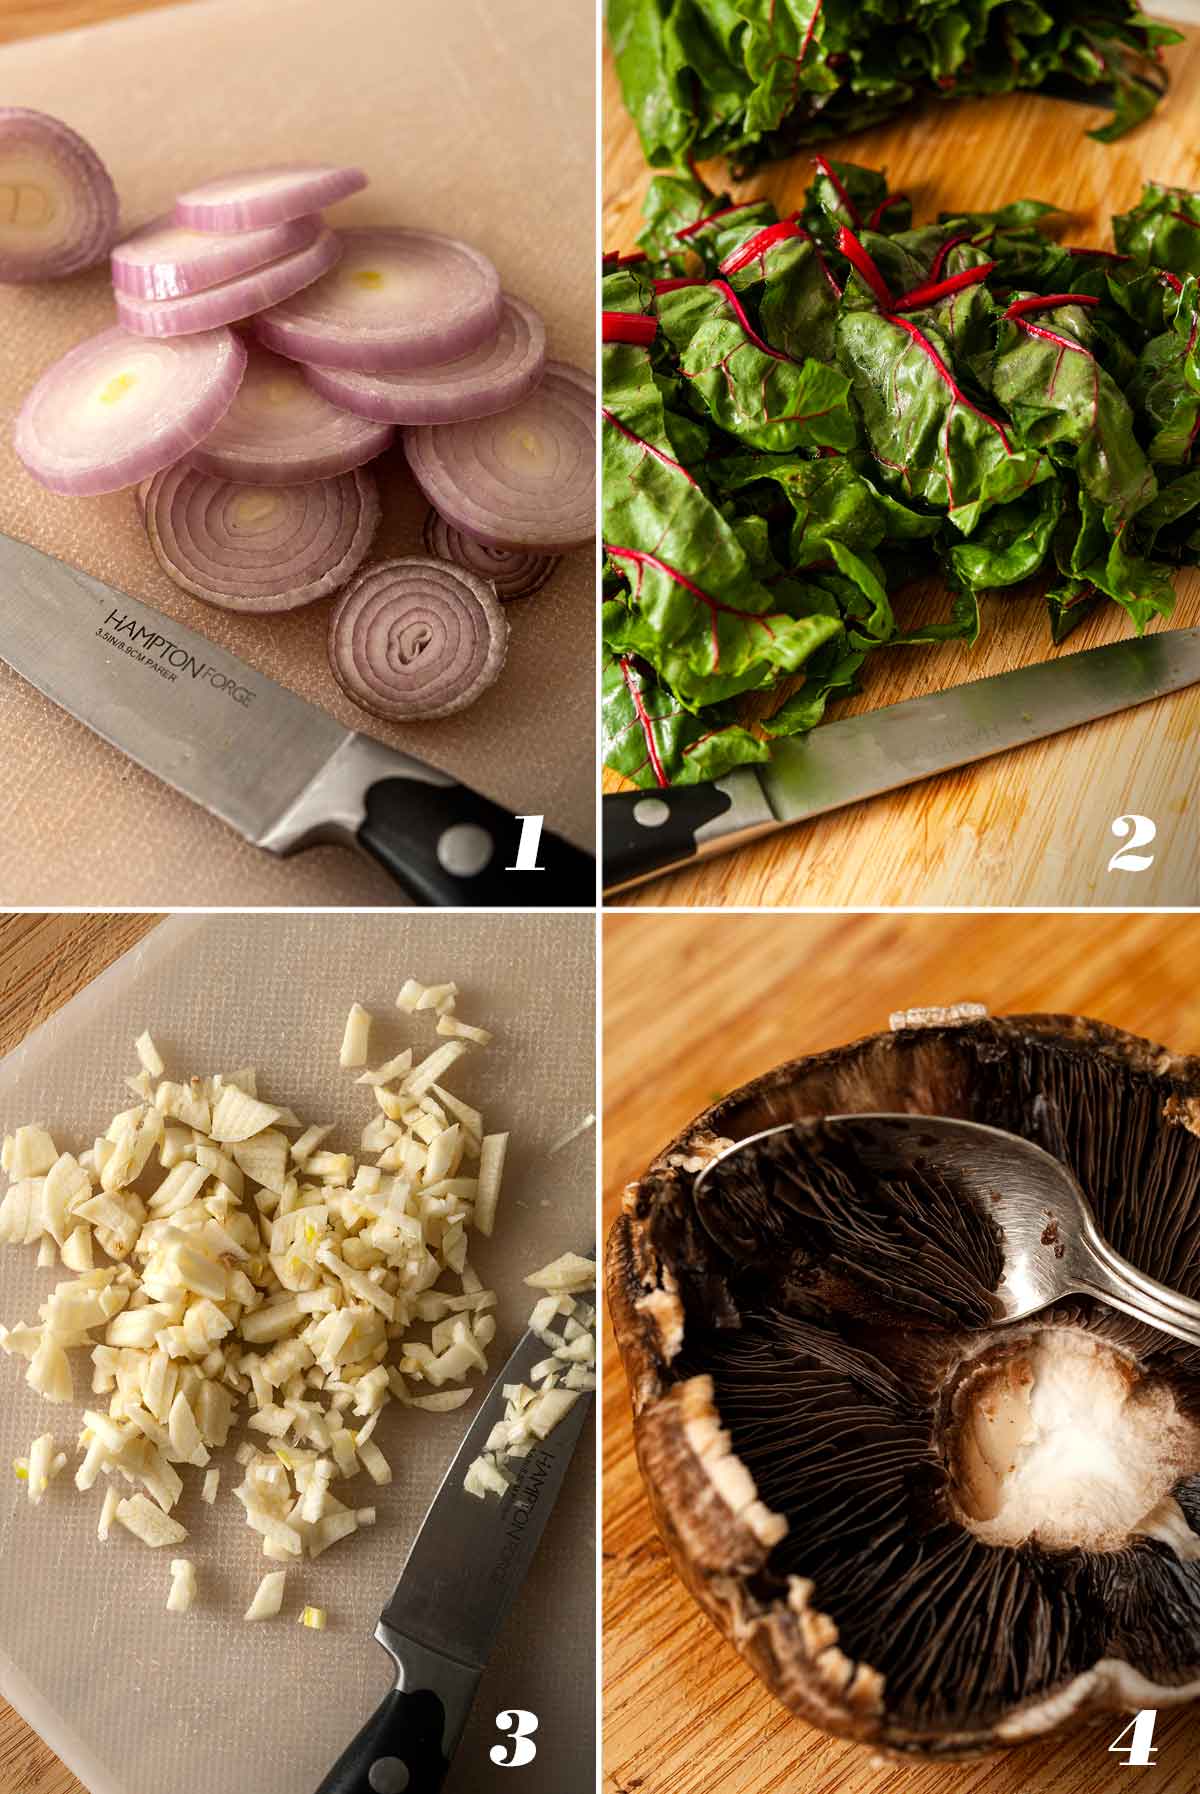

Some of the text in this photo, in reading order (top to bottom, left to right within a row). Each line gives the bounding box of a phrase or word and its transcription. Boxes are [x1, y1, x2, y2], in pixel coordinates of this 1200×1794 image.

[95, 628, 178, 683] 3.5IN/8.9CM PARER
[104, 609, 257, 708] HAMPTON FORGE
